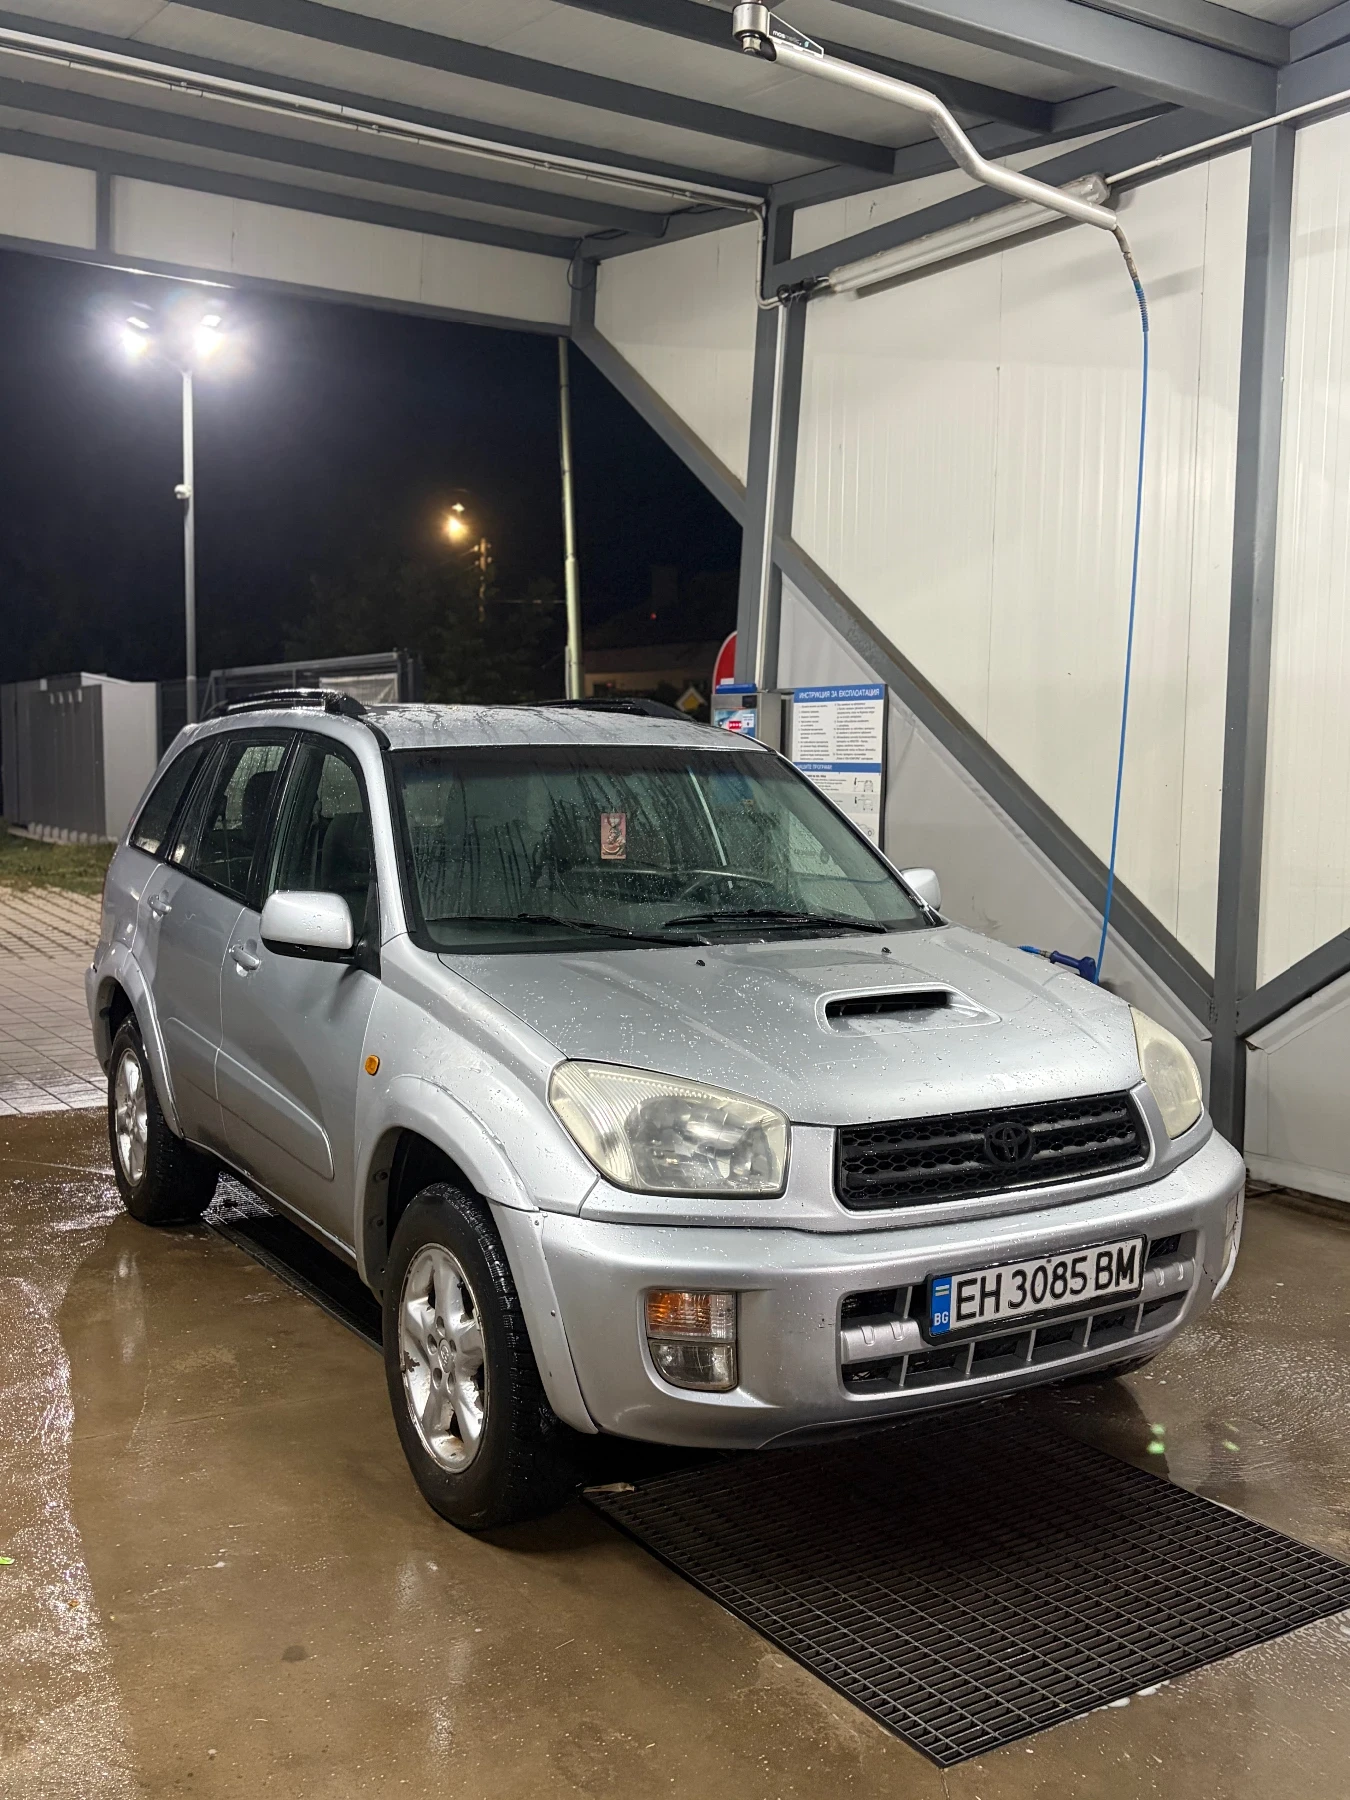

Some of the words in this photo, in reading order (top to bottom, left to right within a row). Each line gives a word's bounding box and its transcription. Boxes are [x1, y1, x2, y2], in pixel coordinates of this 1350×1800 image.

[798, 691, 830, 699] ИНСТРУКЦИЯ
[831, 690, 838, 698] ЗА
[839, 688, 880, 697] ЕКСПЛОАТАЦИЯ
[956, 1273, 1003, 1322] EH
[1008, 1255, 1088, 1309] 3085
[1095, 1245, 1137, 1291] BM
[934, 1311, 949, 1326] BG
